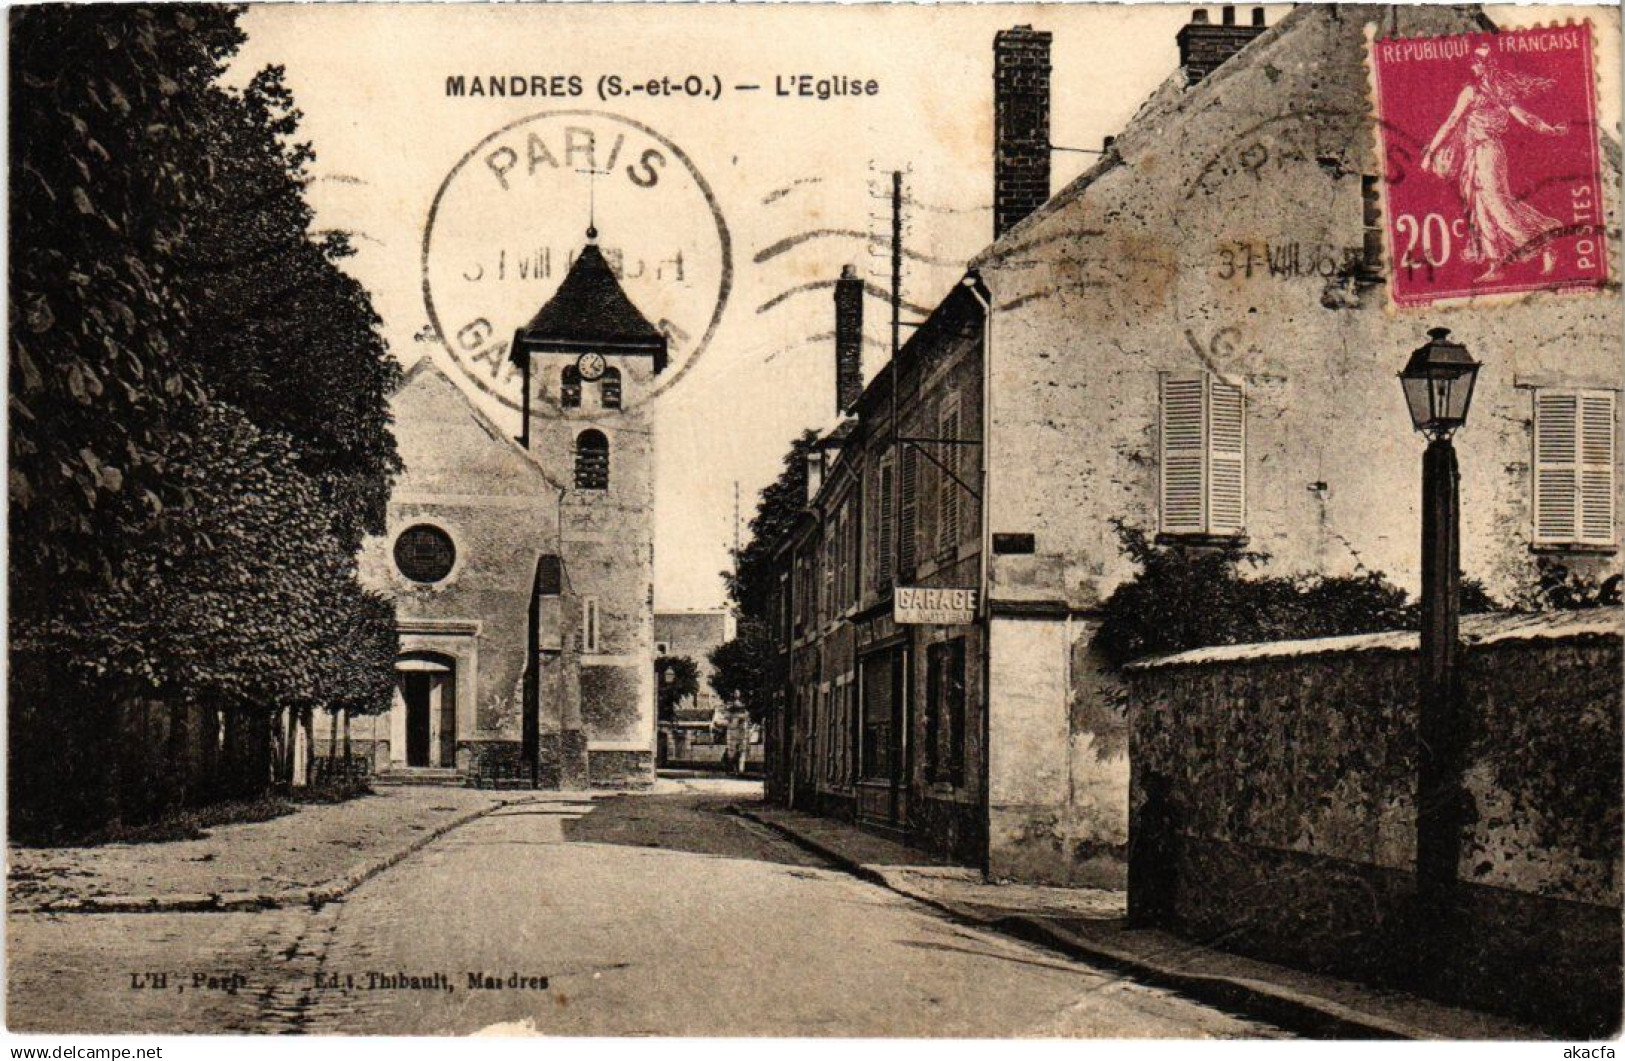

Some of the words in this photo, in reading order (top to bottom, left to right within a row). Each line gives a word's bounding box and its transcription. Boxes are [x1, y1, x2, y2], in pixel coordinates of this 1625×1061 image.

[485, 126, 667, 191] PARIS
[1571, 185, 1596, 269] POSTES
[899, 589, 977, 611] GARAGE
